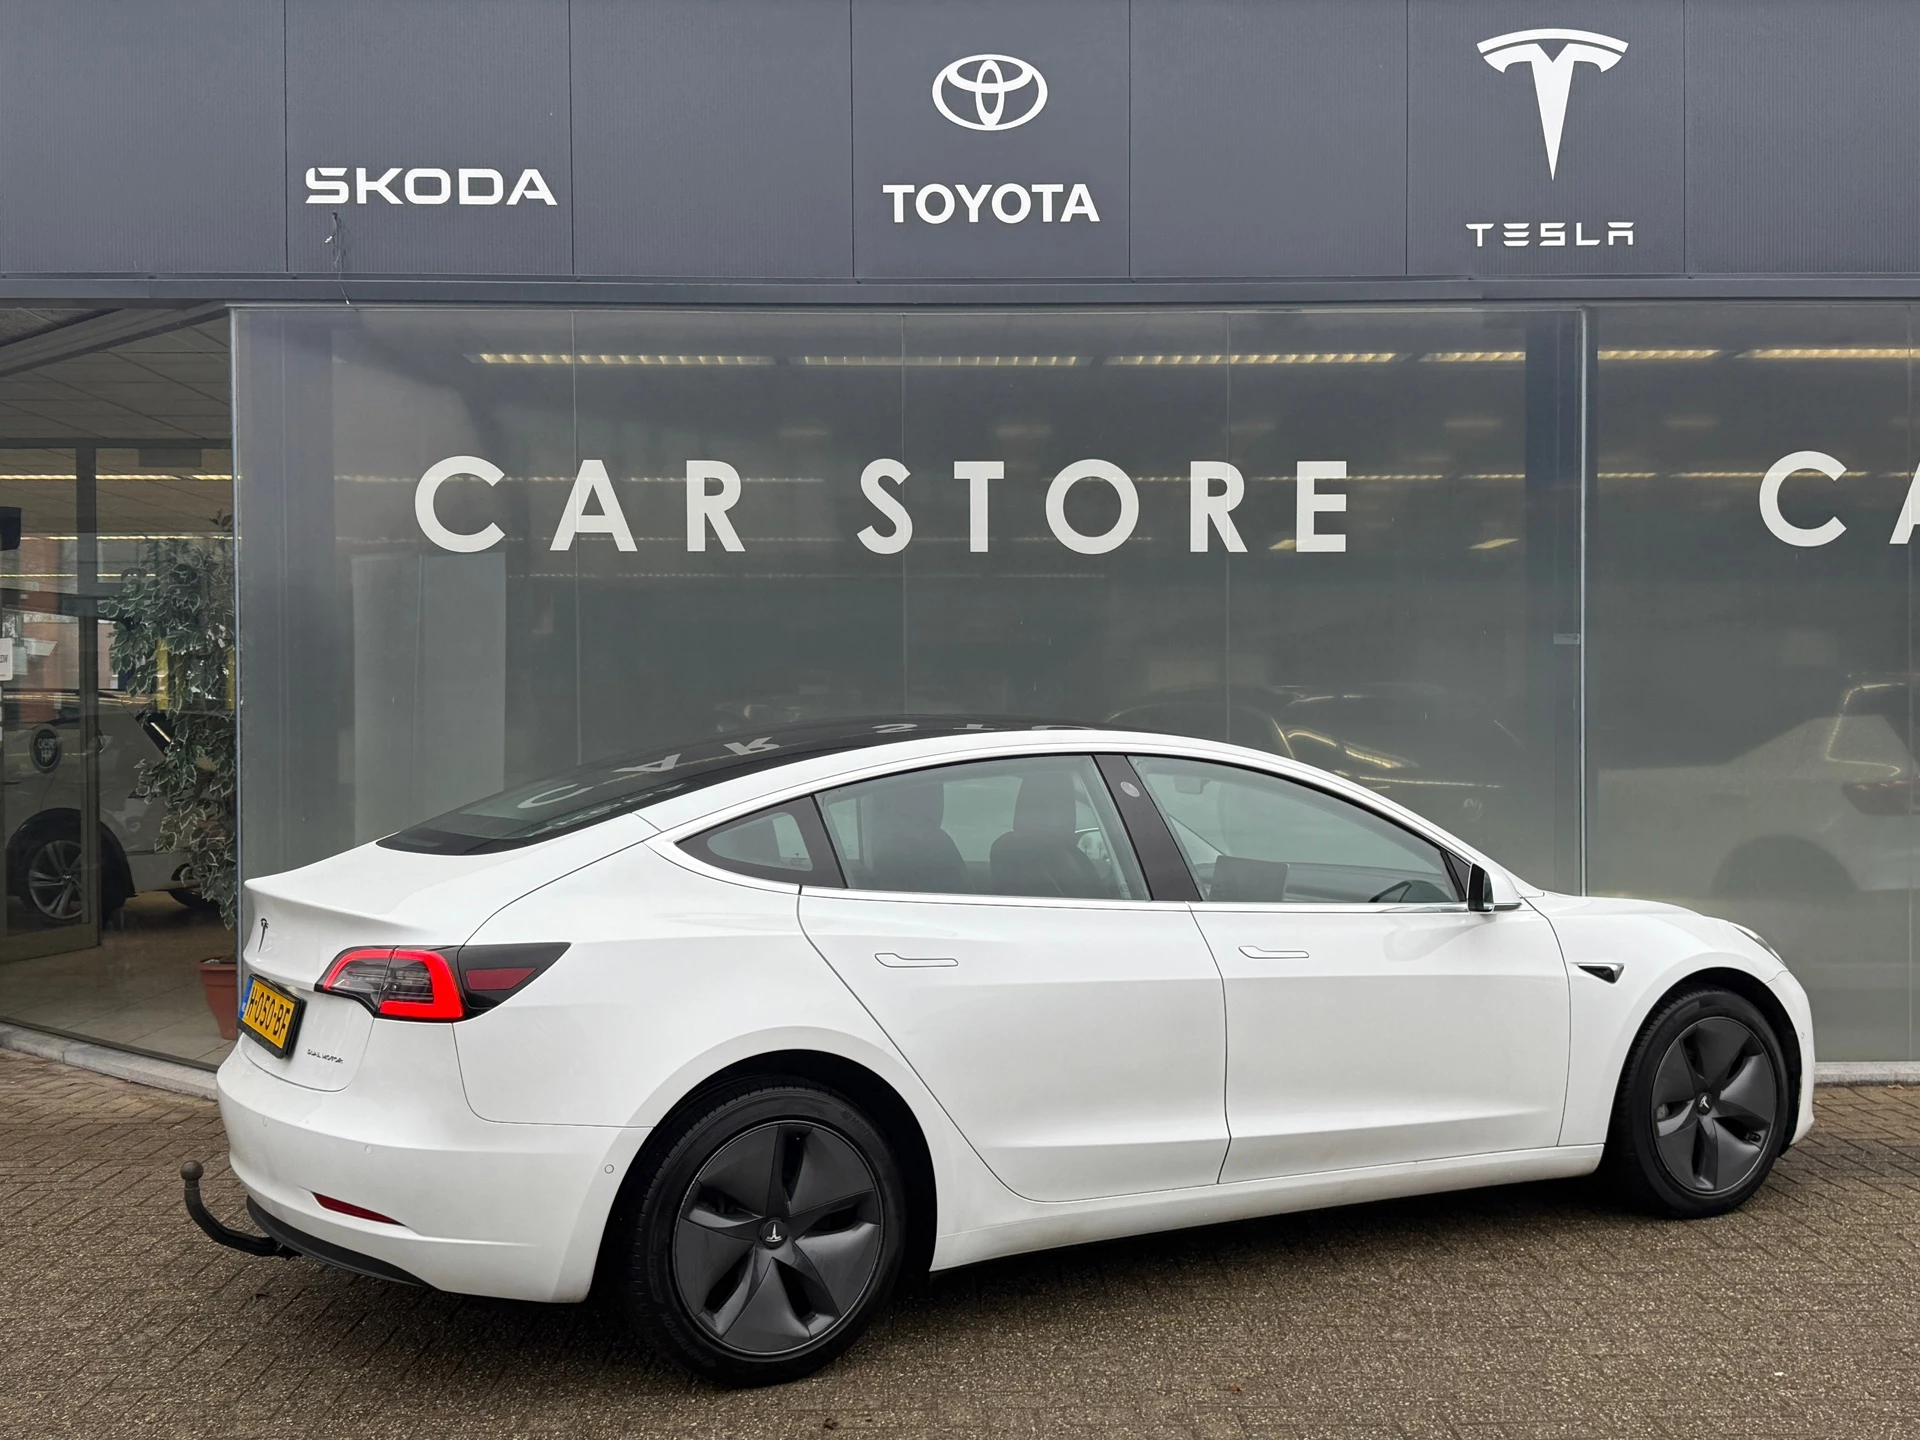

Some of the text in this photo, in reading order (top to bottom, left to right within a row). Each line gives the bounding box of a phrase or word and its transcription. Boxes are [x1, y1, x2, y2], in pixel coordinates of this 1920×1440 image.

[306, 168, 557, 205] SKODA
[883, 184, 1100, 224] TOYOTA
[1466, 222, 1634, 247] TESLA
[415, 456, 1347, 555] CAR STORE
